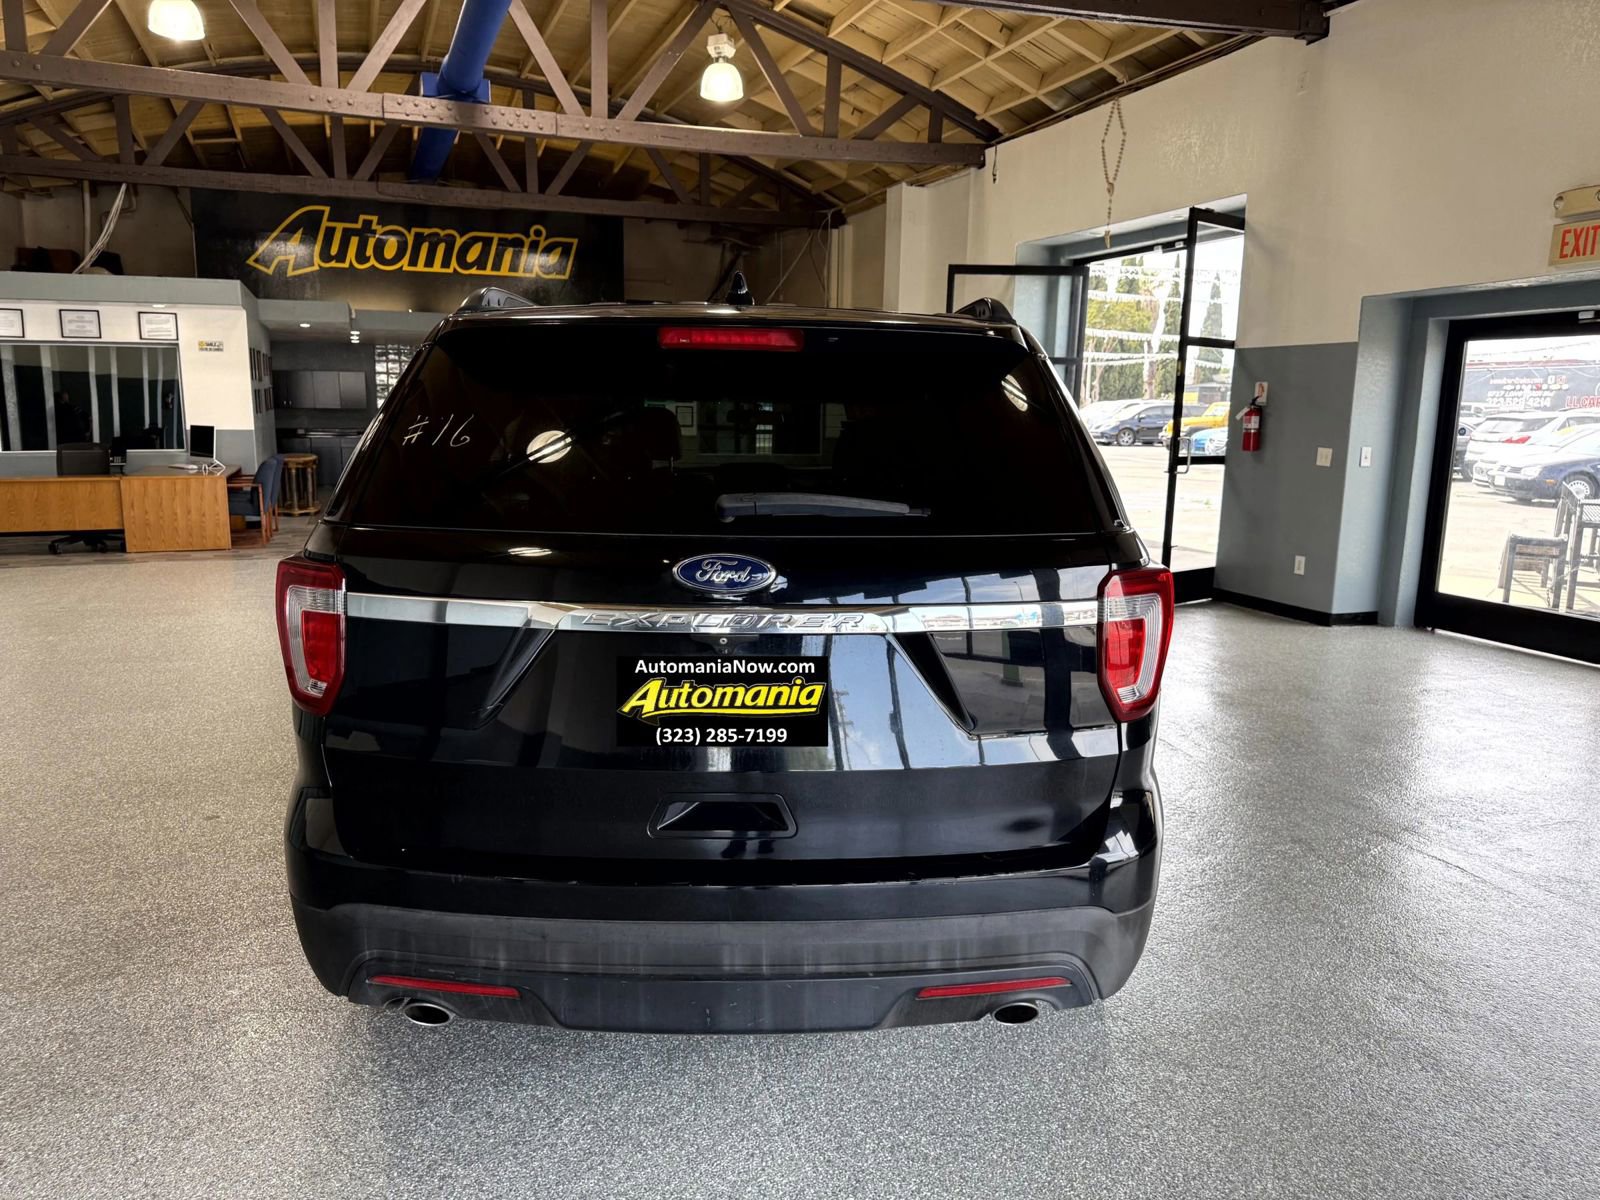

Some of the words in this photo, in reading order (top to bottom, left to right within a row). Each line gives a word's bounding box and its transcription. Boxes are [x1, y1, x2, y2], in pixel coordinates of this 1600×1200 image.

[246, 205, 579, 280] Automania
[1559, 224, 1600, 259] EXIT
[402, 413, 475, 448] #16
[695, 558, 753, 584] Ford
[582, 612, 866, 628] EXPLORER
